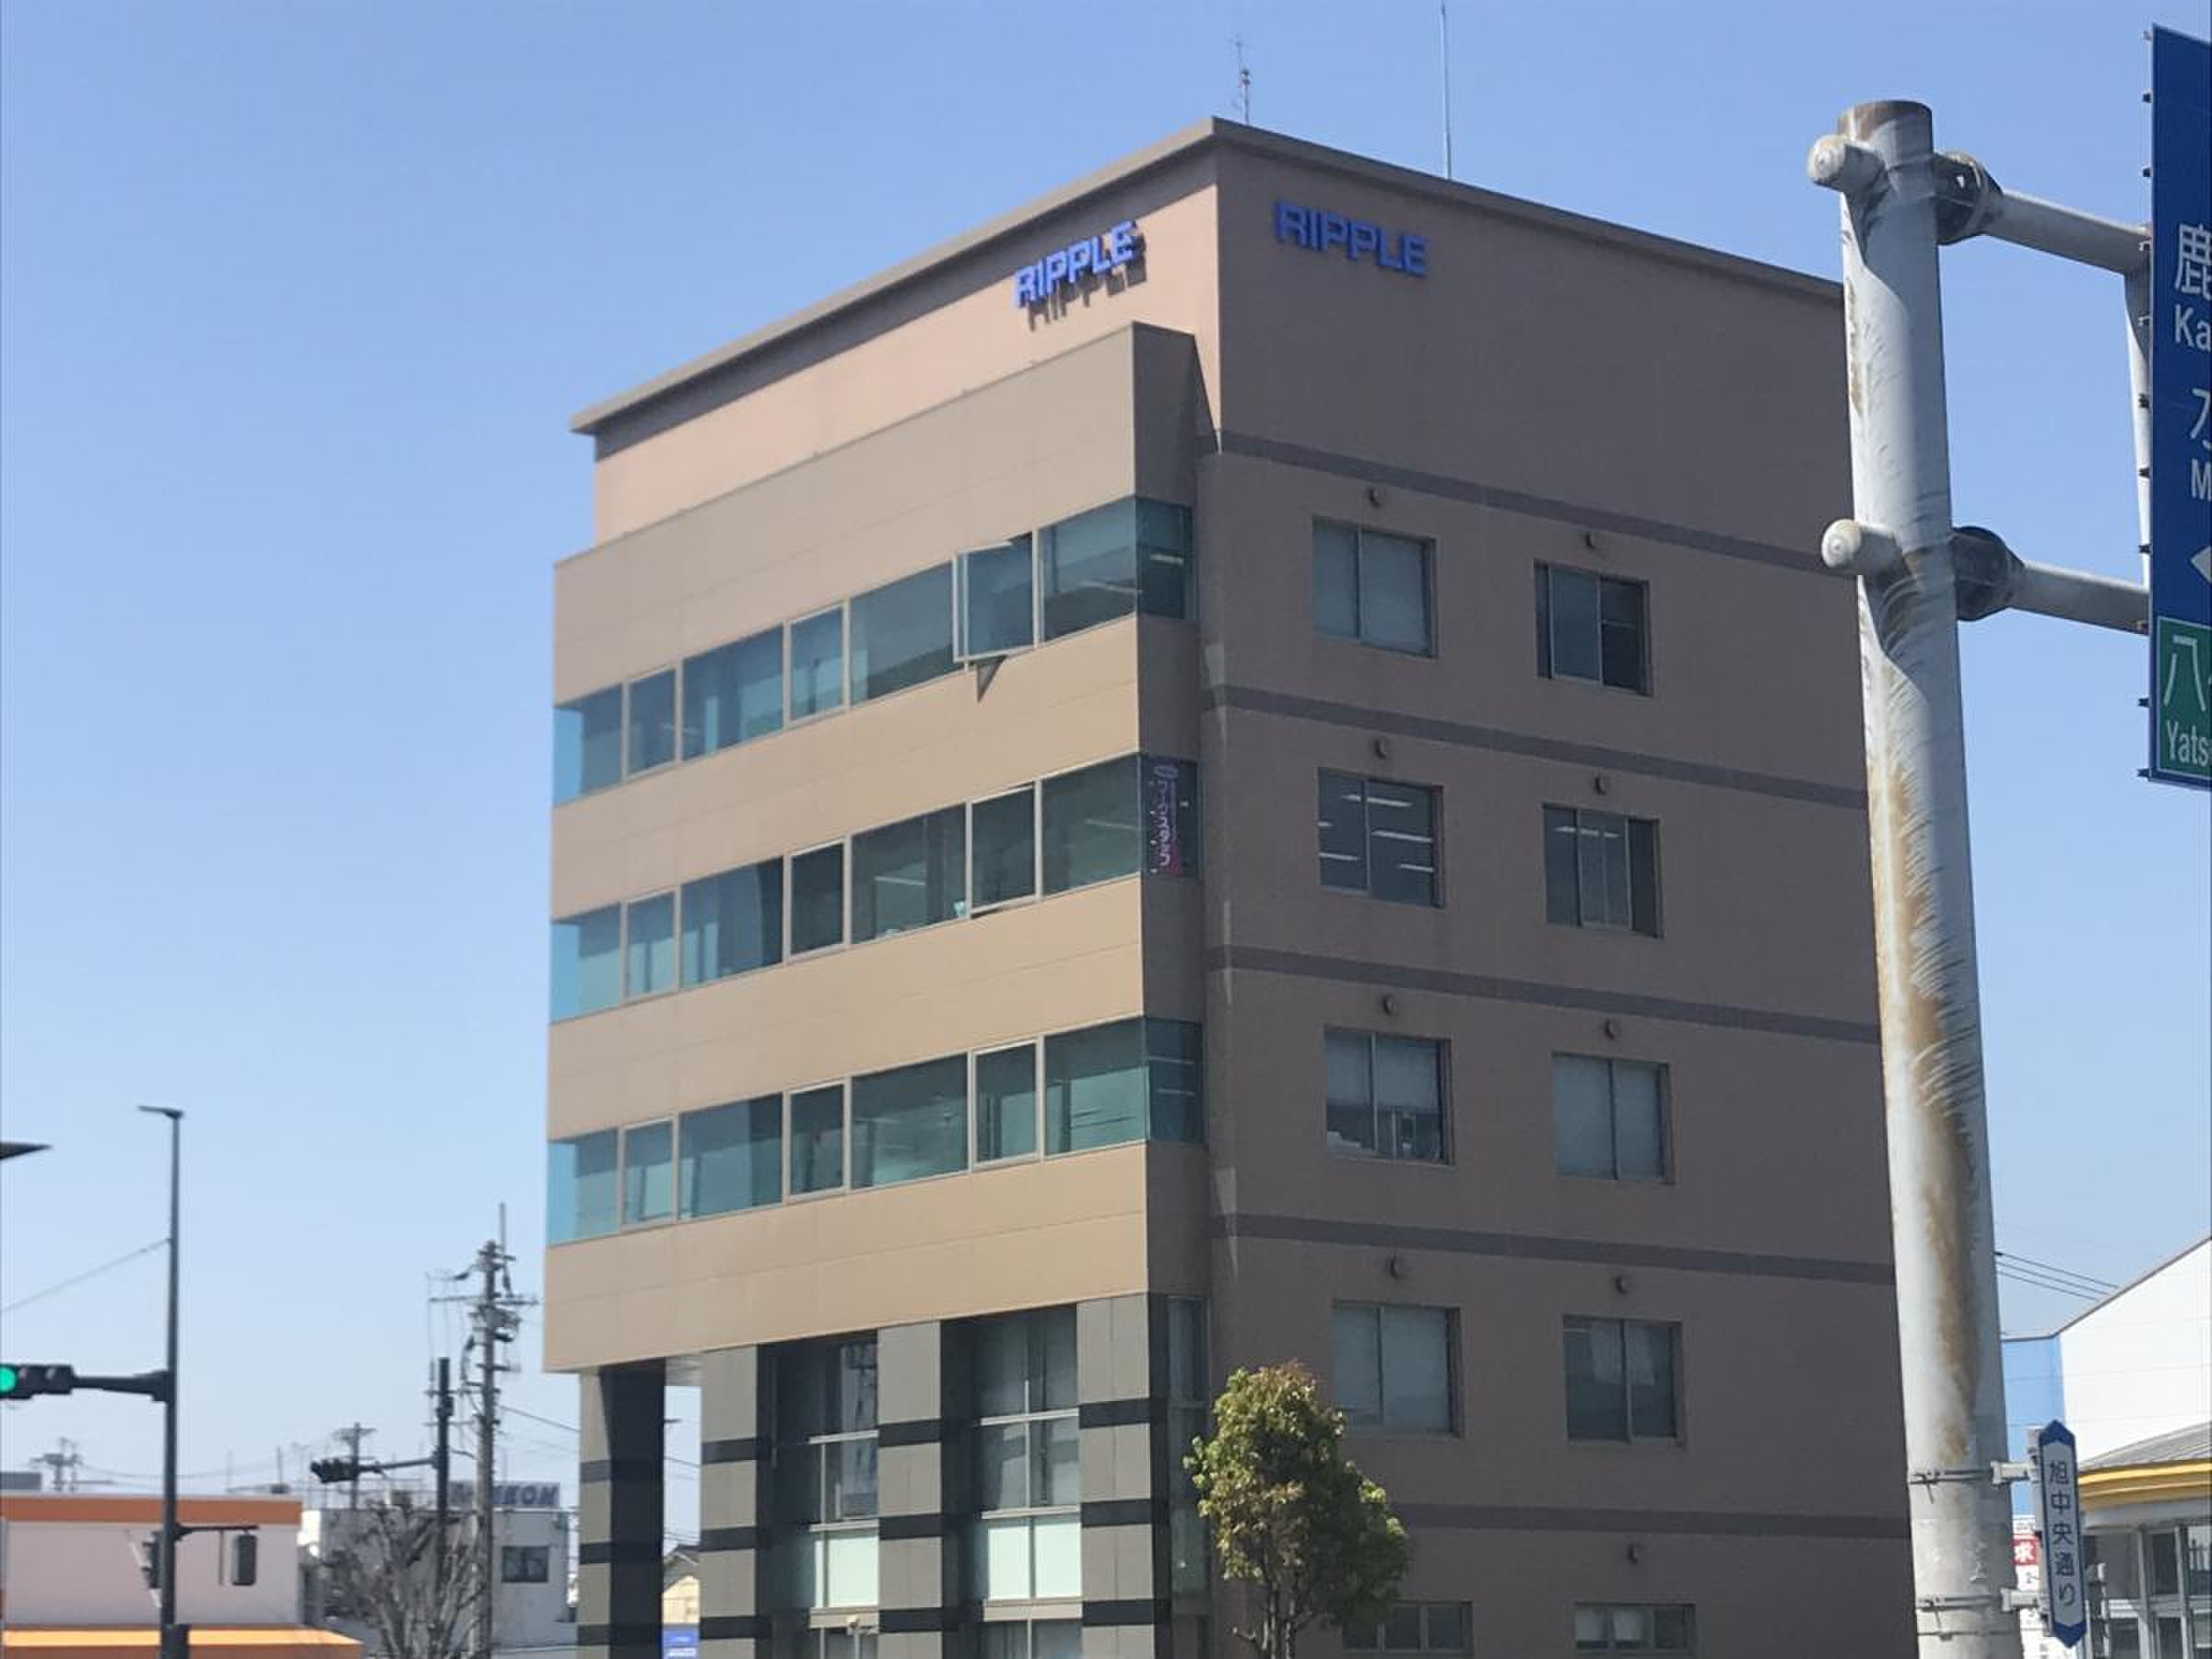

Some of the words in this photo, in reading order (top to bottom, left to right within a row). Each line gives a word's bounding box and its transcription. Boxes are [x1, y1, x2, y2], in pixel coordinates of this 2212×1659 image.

[1013, 220, 1136, 309] RIPPLE
[1274, 199, 1428, 278] RIPPLE
[2049, 1460, 2076, 1606] 旭中央通り
